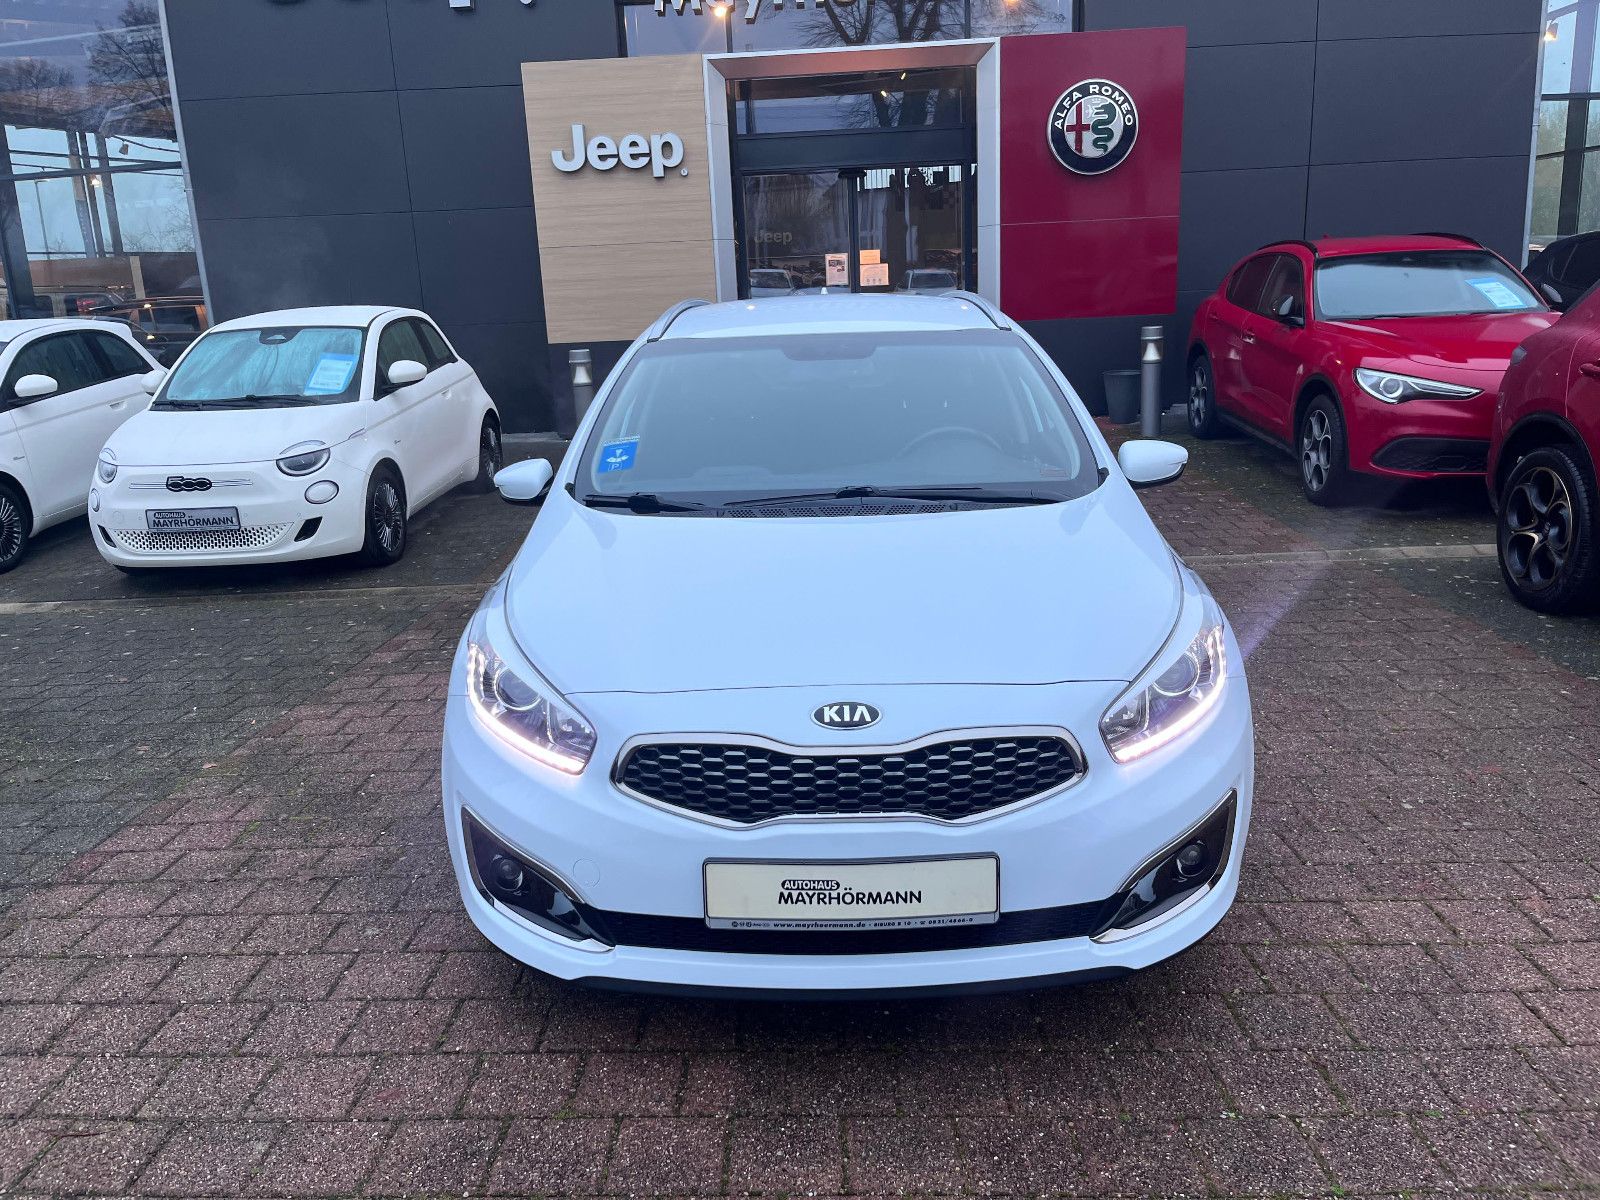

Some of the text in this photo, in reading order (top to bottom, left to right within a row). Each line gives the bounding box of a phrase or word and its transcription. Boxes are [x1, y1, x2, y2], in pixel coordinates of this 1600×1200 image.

[1054, 84, 1134, 130] ALFA ROMEO
[551, 124, 684, 178] Jeep
[754, 229, 793, 246] Jeep
[166, 475, 213, 492] 500
[152, 515, 234, 528] MAYRHÖRMANN
[823, 704, 872, 723] KIA
[783, 880, 838, 890] AUTOHAUS
[778, 887, 922, 905] MAYRHÖRMANN
[773, 921, 866, 929] www.mayrhoermann.de
